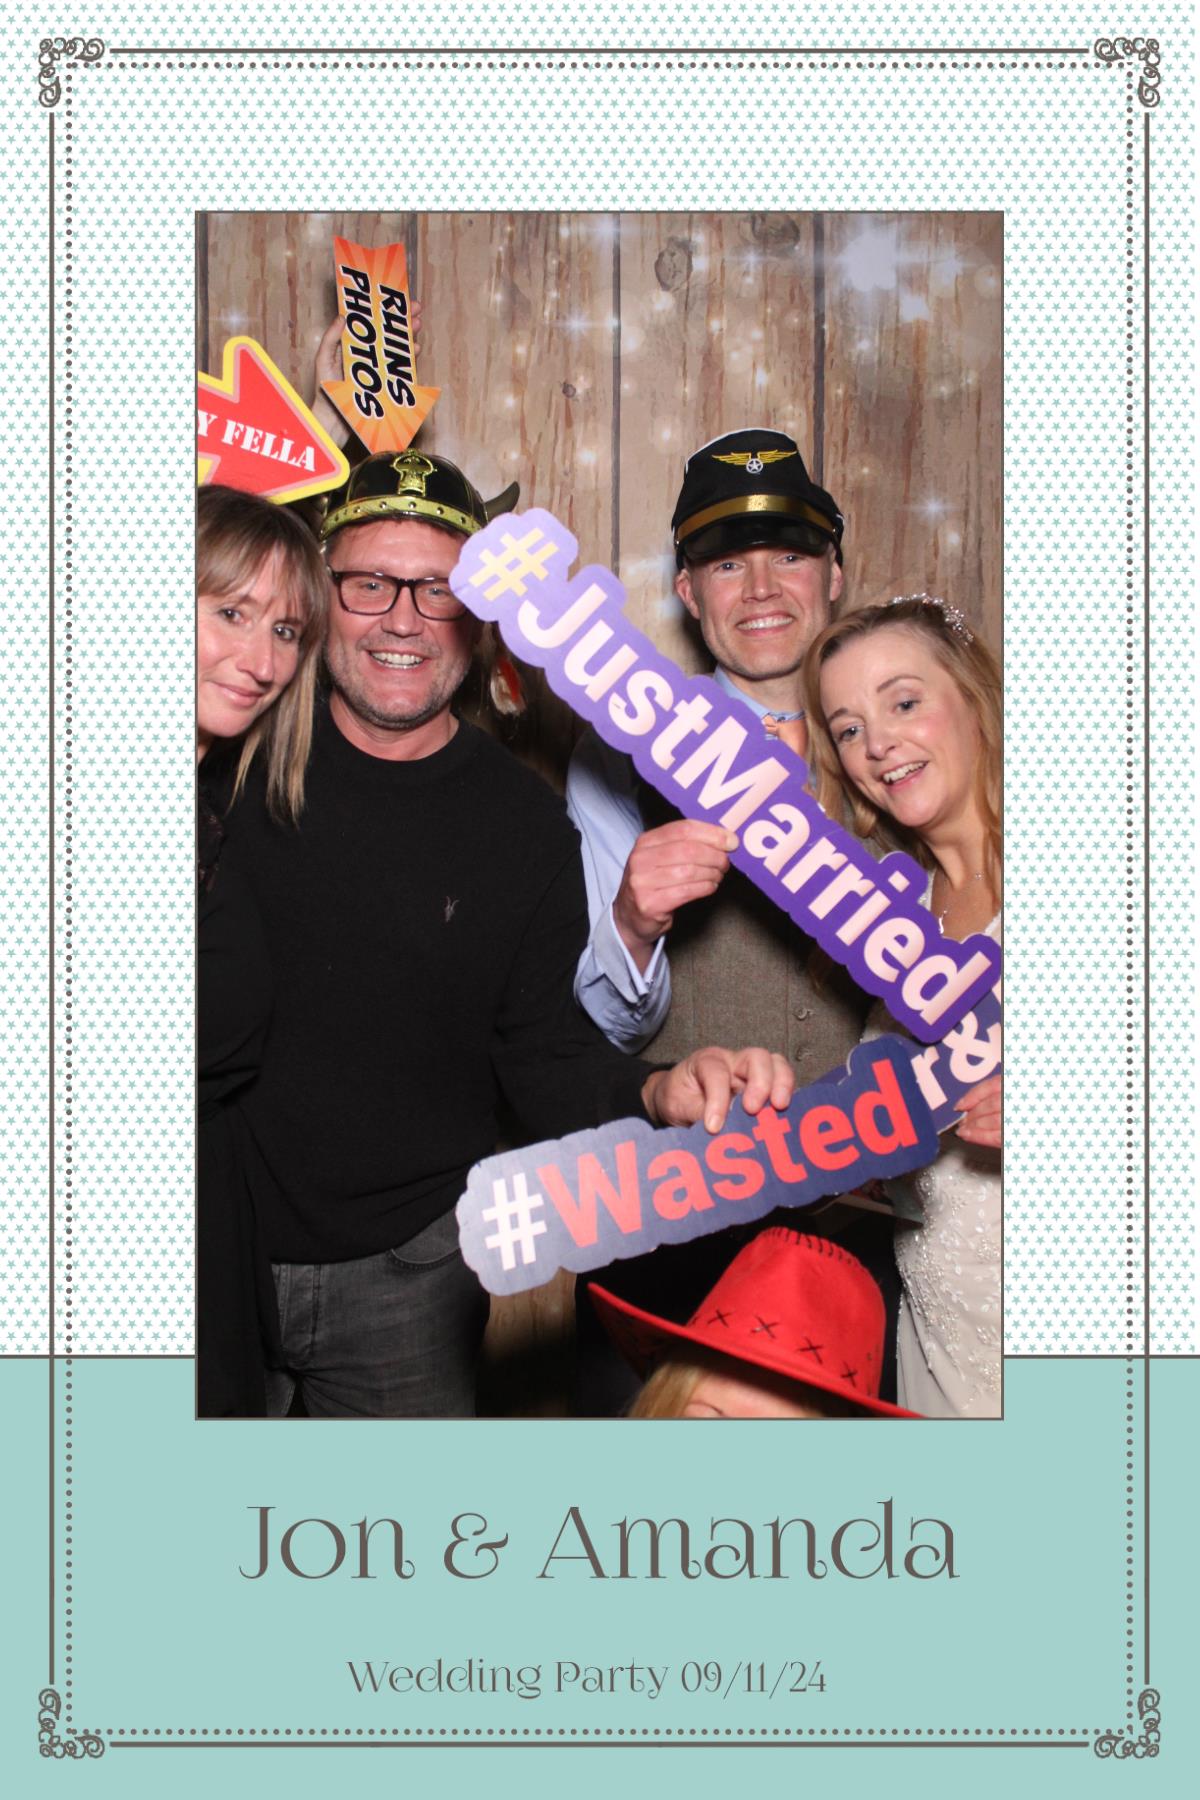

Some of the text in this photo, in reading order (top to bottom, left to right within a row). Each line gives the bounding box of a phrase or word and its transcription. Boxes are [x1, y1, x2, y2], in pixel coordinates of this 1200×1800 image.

[339, 264, 385, 420] PHOTOS
[378, 284, 416, 408] RUINS
[198, 409, 316, 472] Y FELLA
[468, 527, 992, 1026] #JustMarried
[481, 1059, 919, 1272] #Wasted
